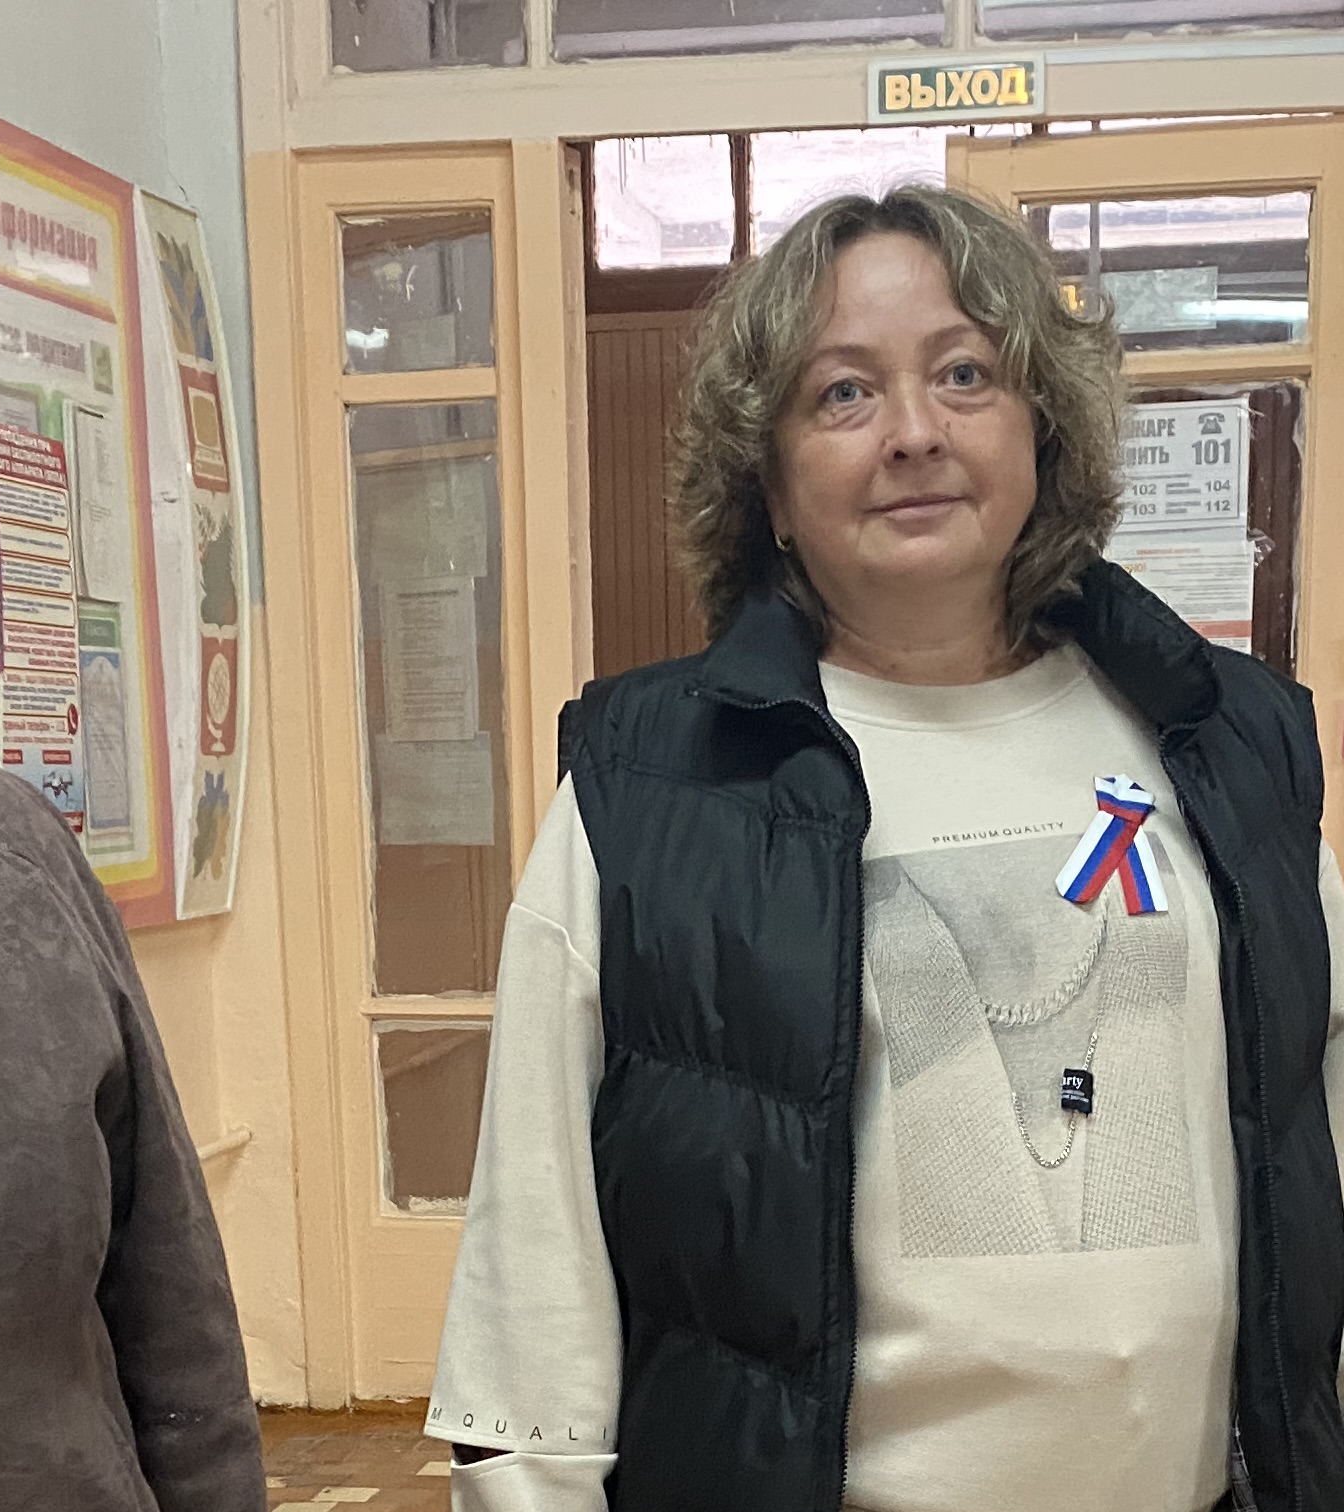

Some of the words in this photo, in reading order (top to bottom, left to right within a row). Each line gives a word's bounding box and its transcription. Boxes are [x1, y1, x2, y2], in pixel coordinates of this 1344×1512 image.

[885, 67, 1028, 110] ВЫХОД
[1125, 446, 1170, 467] НИТЬ
[1192, 438, 1231, 465] 101
[1132, 483, 1157, 496] 102
[1205, 480, 1230, 492] 104
[1132, 503, 1156, 516] 103
[1205, 500, 1230, 512] 112
[932, 829, 999, 844] PREMIUM
[1002, 821, 1064, 836] QUALITY
[463, 1413, 607, 1441] QUALI
